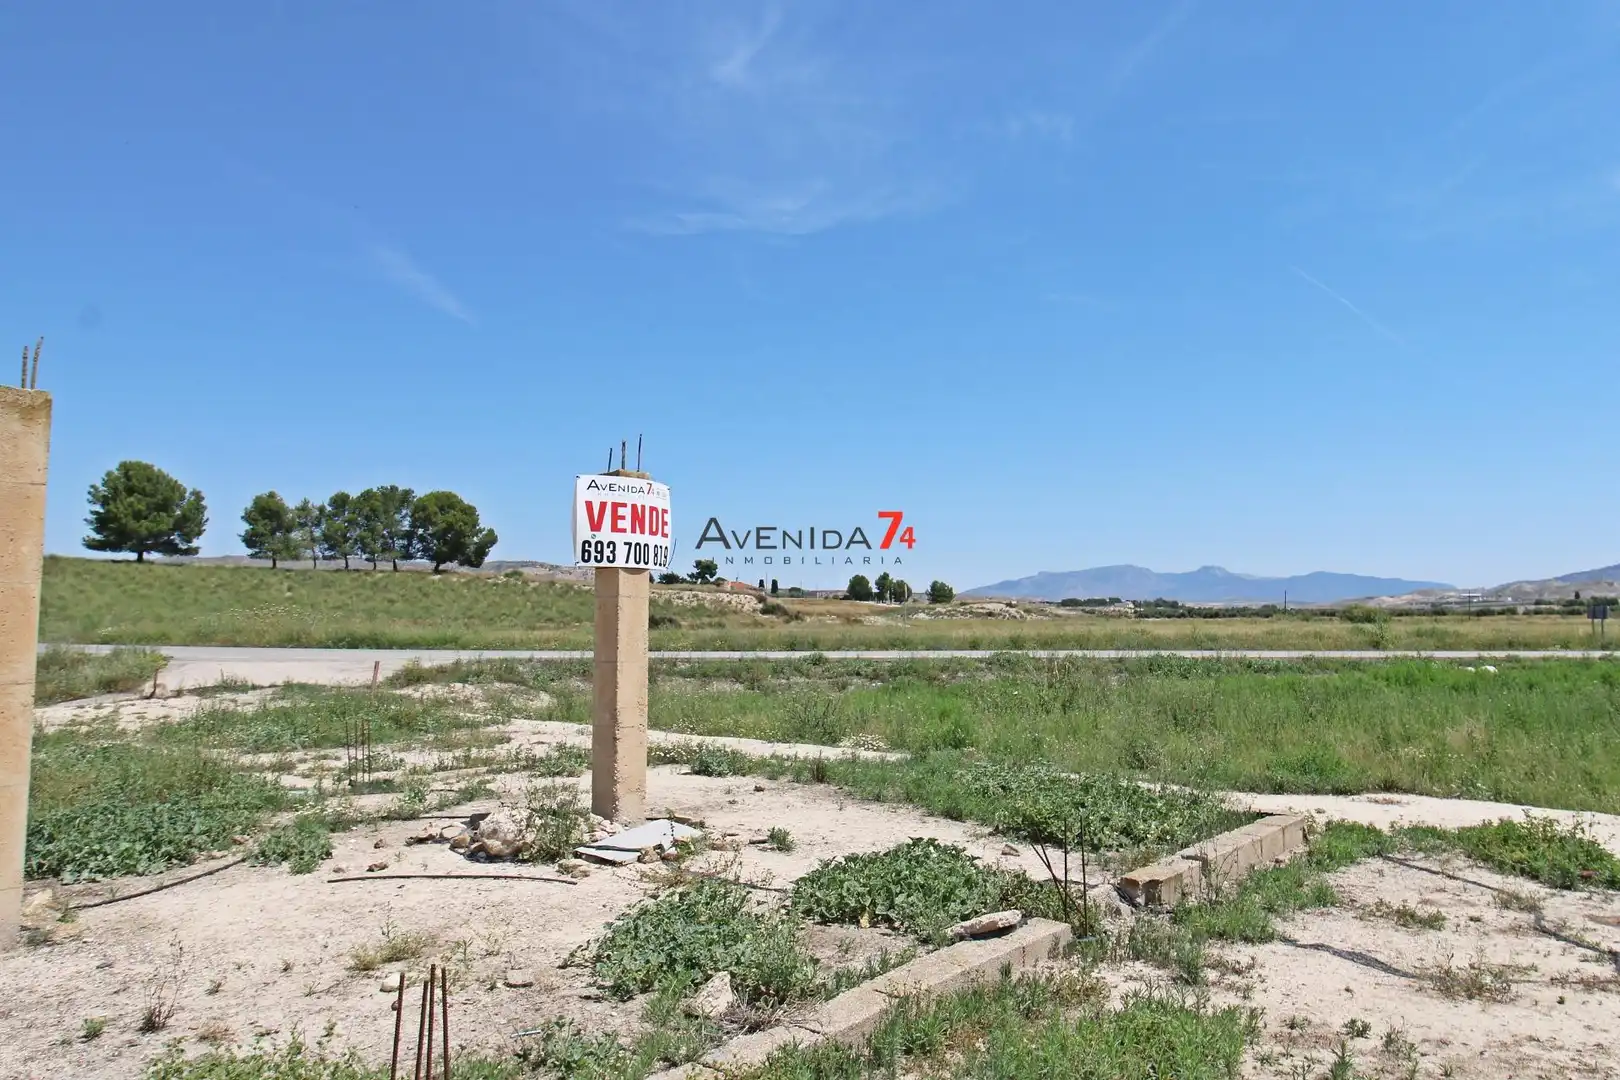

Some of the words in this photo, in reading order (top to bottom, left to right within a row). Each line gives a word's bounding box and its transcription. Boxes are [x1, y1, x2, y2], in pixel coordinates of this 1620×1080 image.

[585, 500, 669, 538] VENDE
[581, 540, 616, 563] 693
[623, 541, 650, 566] 700
[653, 544, 668, 567] 819
